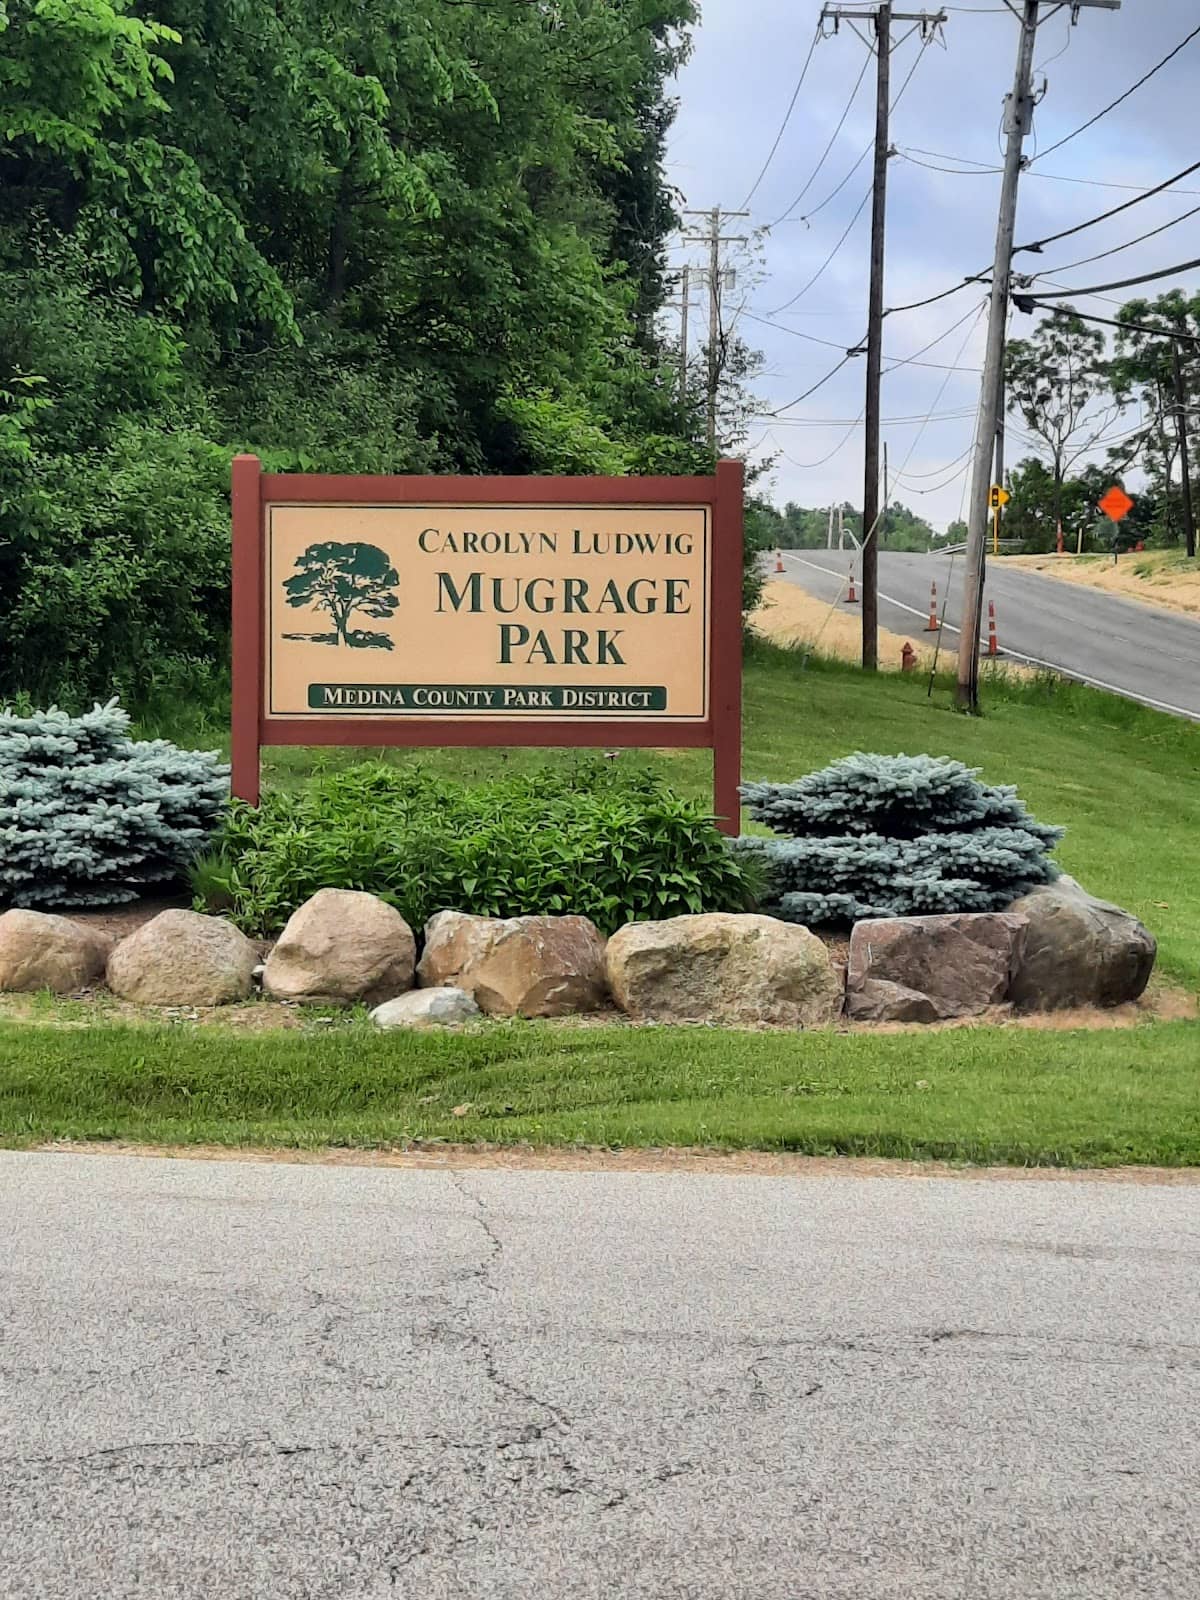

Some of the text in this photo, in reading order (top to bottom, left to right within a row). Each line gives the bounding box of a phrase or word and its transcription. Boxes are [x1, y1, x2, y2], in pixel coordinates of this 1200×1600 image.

[418, 528, 694, 555] CAROLYN LUDWIG
[435, 571, 692, 615] MUGRAGE
[495, 623, 627, 665] PARK
[322, 687, 653, 708] MEDINA COUNTY PARK DISTRICT
